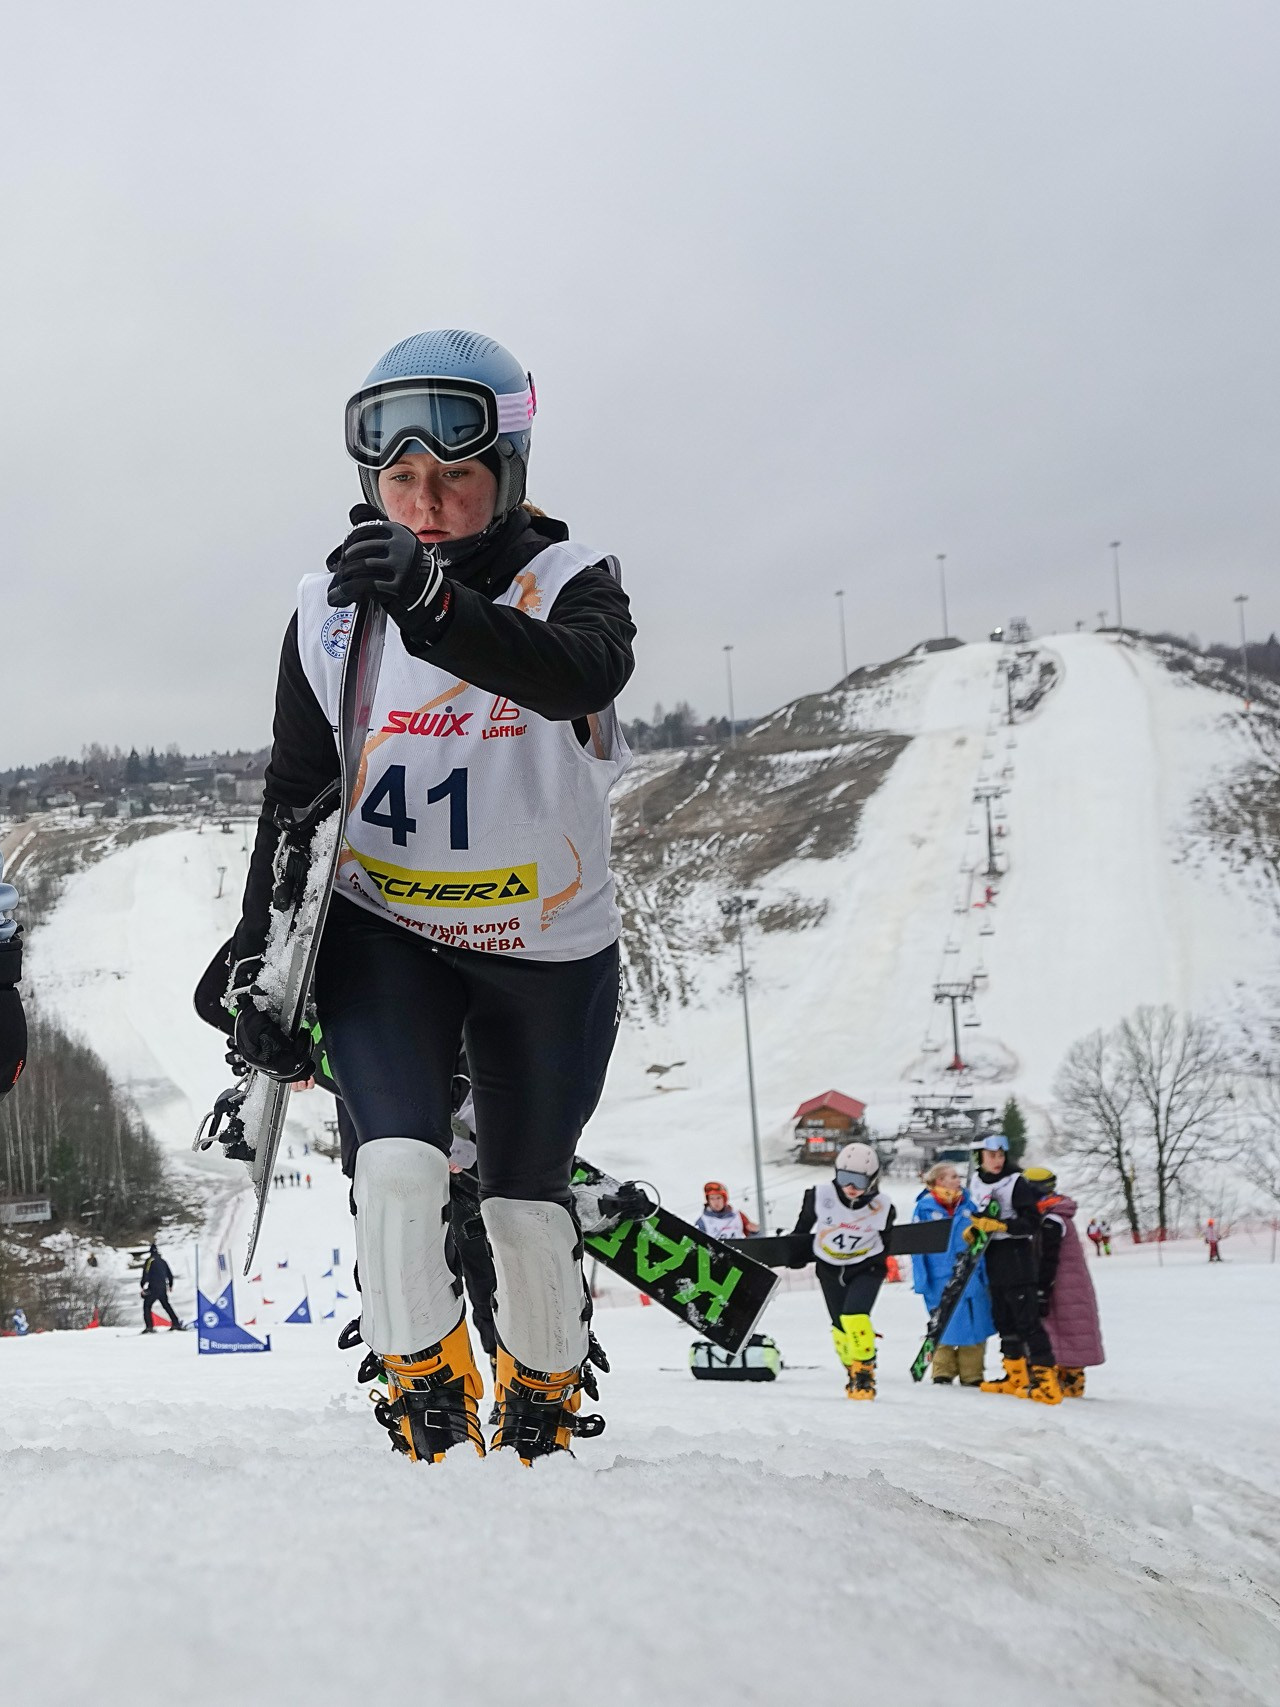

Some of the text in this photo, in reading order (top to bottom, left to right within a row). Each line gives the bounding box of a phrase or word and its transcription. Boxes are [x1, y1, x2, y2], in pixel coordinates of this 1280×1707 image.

[482, 724, 528, 740] Löffler
[361, 764, 469, 850] 41
[832, 1233, 863, 1250] 47
